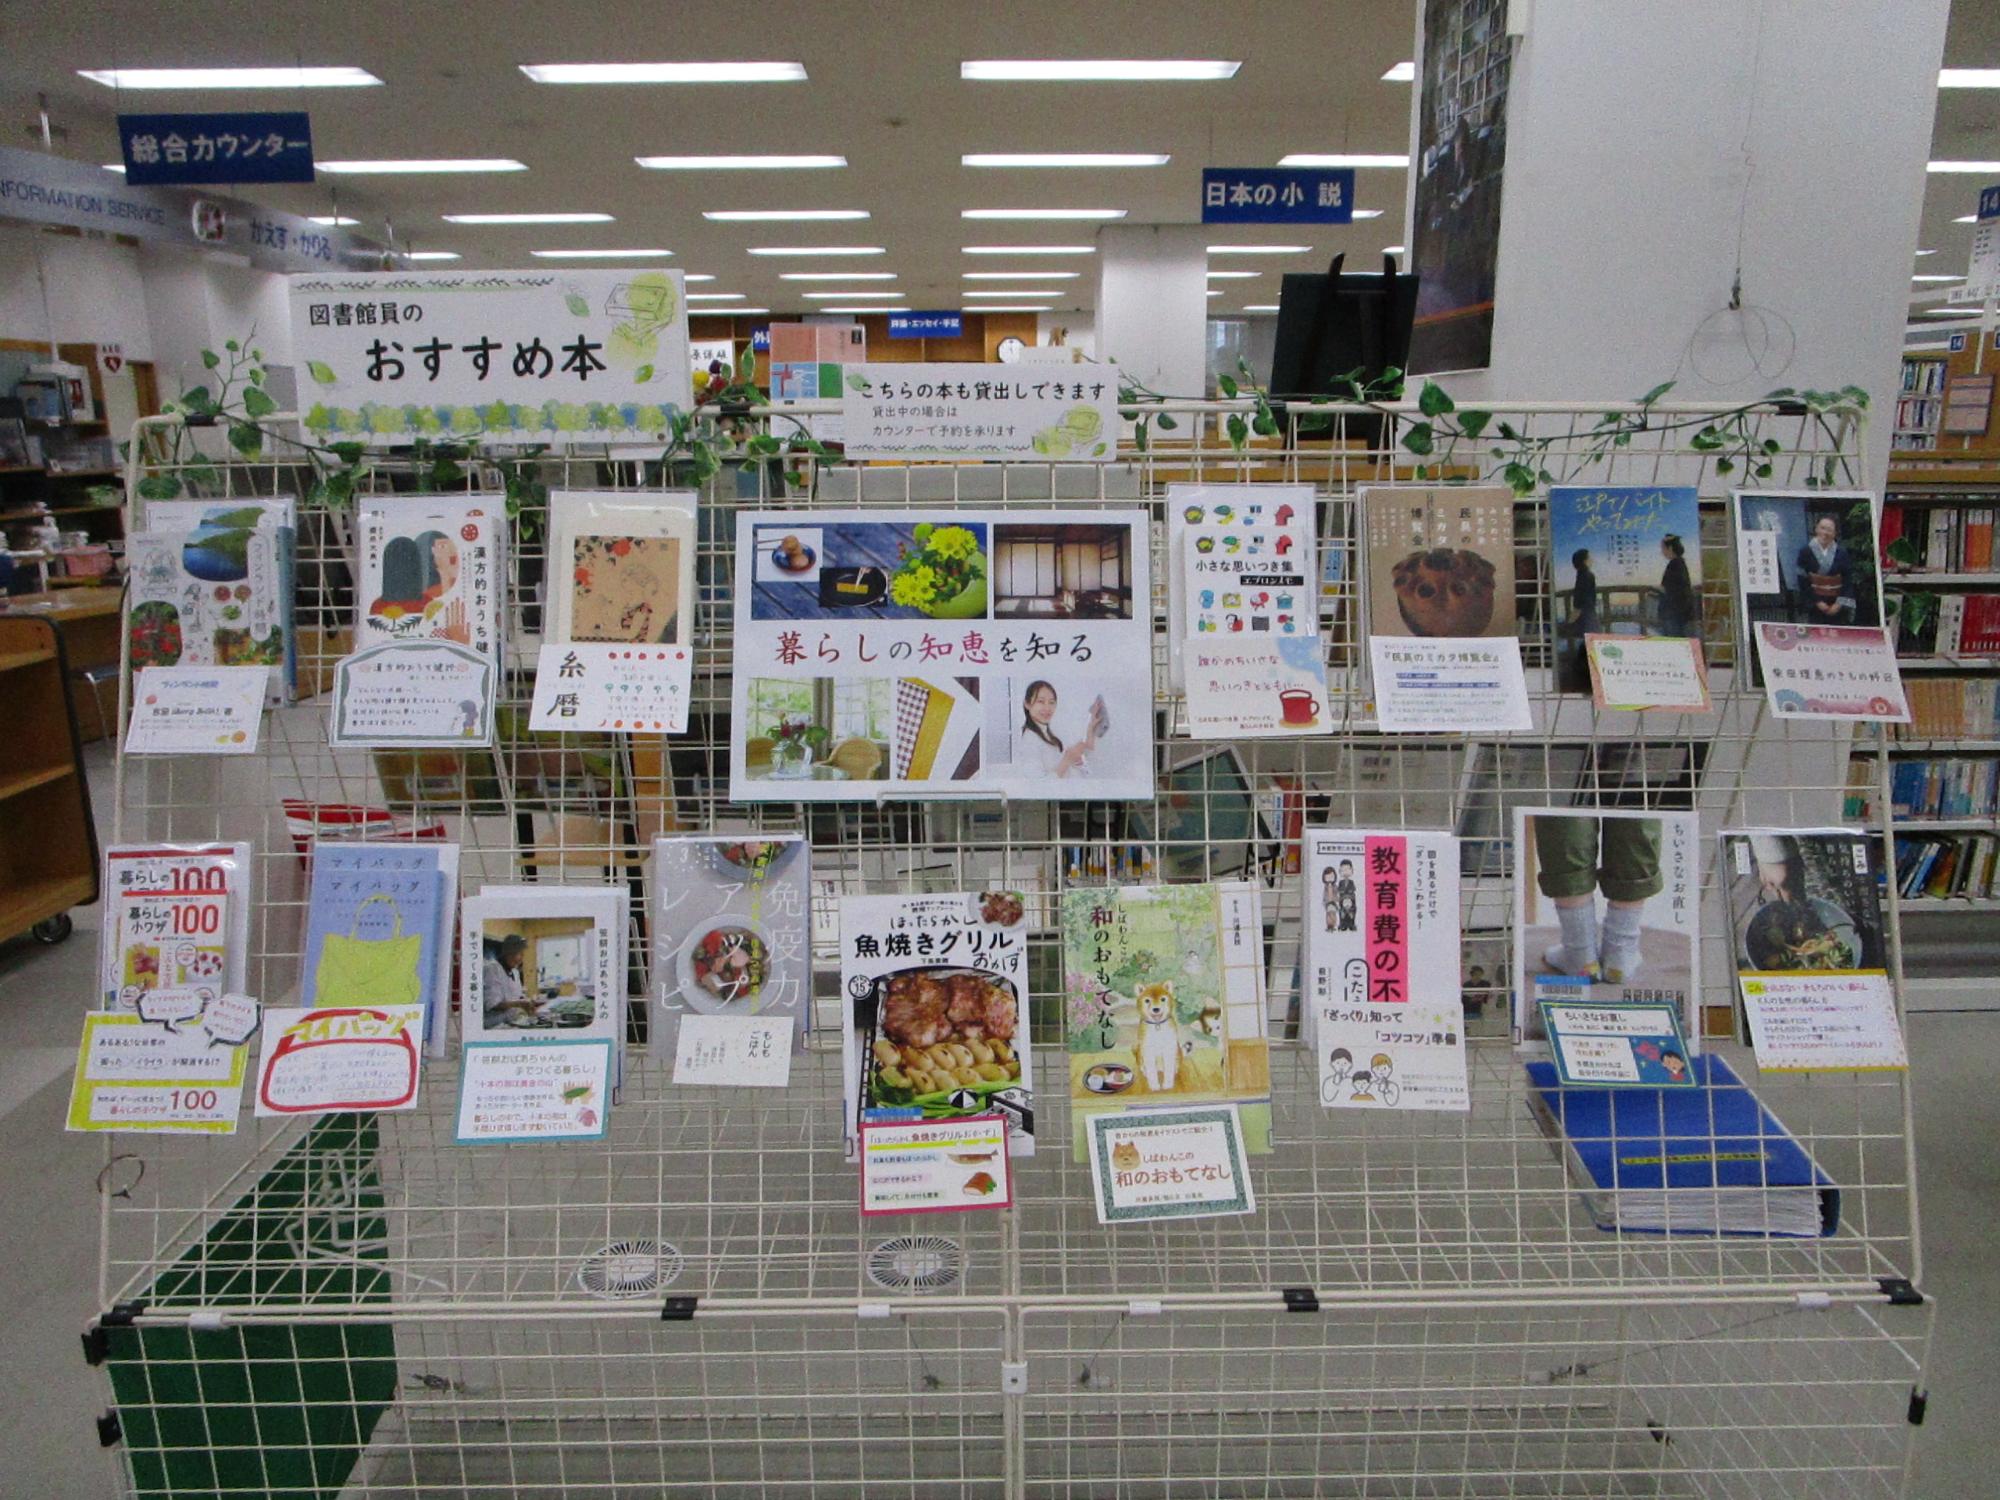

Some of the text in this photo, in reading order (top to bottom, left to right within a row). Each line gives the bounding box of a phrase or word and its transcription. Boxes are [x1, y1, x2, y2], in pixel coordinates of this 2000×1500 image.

[130, 133, 310, 164] 総合カウンター
[1206, 181, 1342, 207] 日本の小説
[309, 302, 423, 326] 図書館員の
[365, 333, 607, 382] おすすめ本
[861, 381, 1106, 401] こちらの本も貸出しできます
[872, 405, 958, 418] 貸出中の場合は
[872, 424, 1015, 438] カウンターで予約を承ります
[1195, 560, 1294, 573] 小さな思いつき集
[774, 630, 1094, 666] 暮らしの知恵を知る
[546, 692, 580, 717] 暦
[119, 870, 170, 885] 暮らしの
[1672, 823, 1686, 925] ちいさなお直し
[331, 881, 420, 893] マイバッグ
[129, 904, 219, 934] 暮らしの 100
[131, 921, 168, 934] 小ワザ
[890, 915, 979, 929] ほったらかし
[854, 930, 1014, 959] 魚焼きグリル
[1089, 904, 1117, 1051] 和のおもてなし
[748, 1030, 761, 1058] ごはん
[762, 1031, 773, 1058] もしも
[170, 1090, 218, 1110] 100
[1142, 1151, 1195, 1164] しばわんこの
[1115, 1163, 1231, 1188] 和のおもてなし
